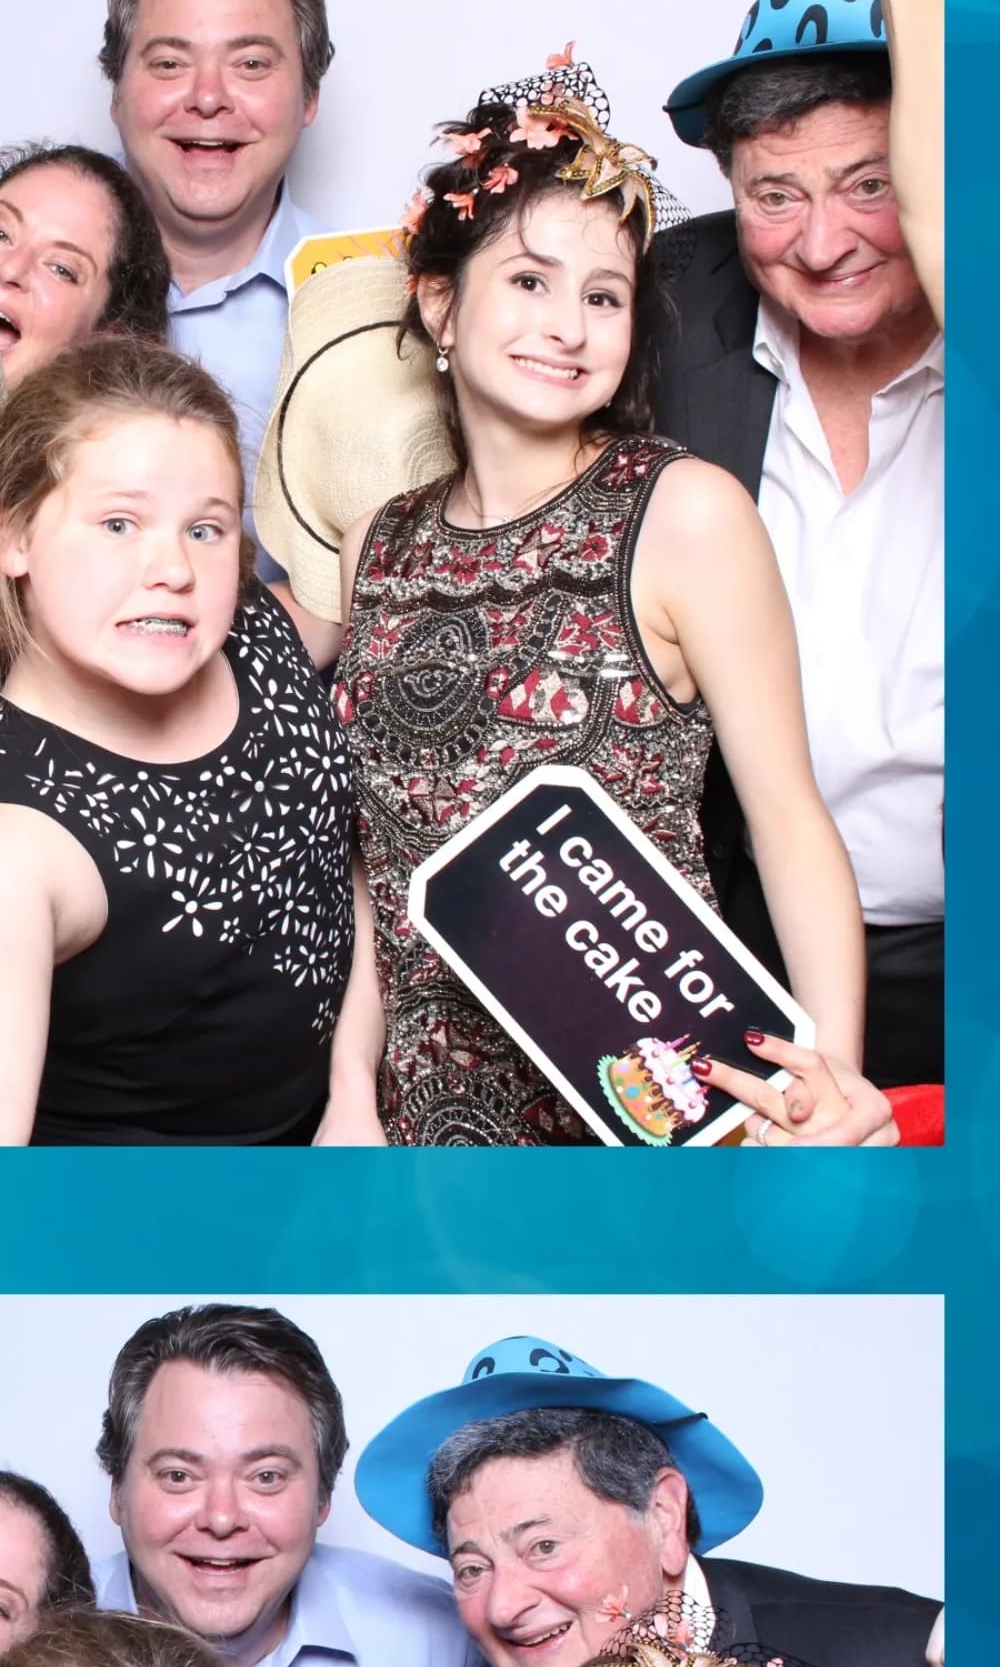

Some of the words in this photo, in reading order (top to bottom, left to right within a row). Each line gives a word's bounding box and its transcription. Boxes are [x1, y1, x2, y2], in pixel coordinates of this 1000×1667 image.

[499, 839, 568, 918] the
[565, 920, 662, 1023] cake
[536, 803, 572, 836] I
[559, 836, 669, 953] came
[663, 949, 735, 1018] for
